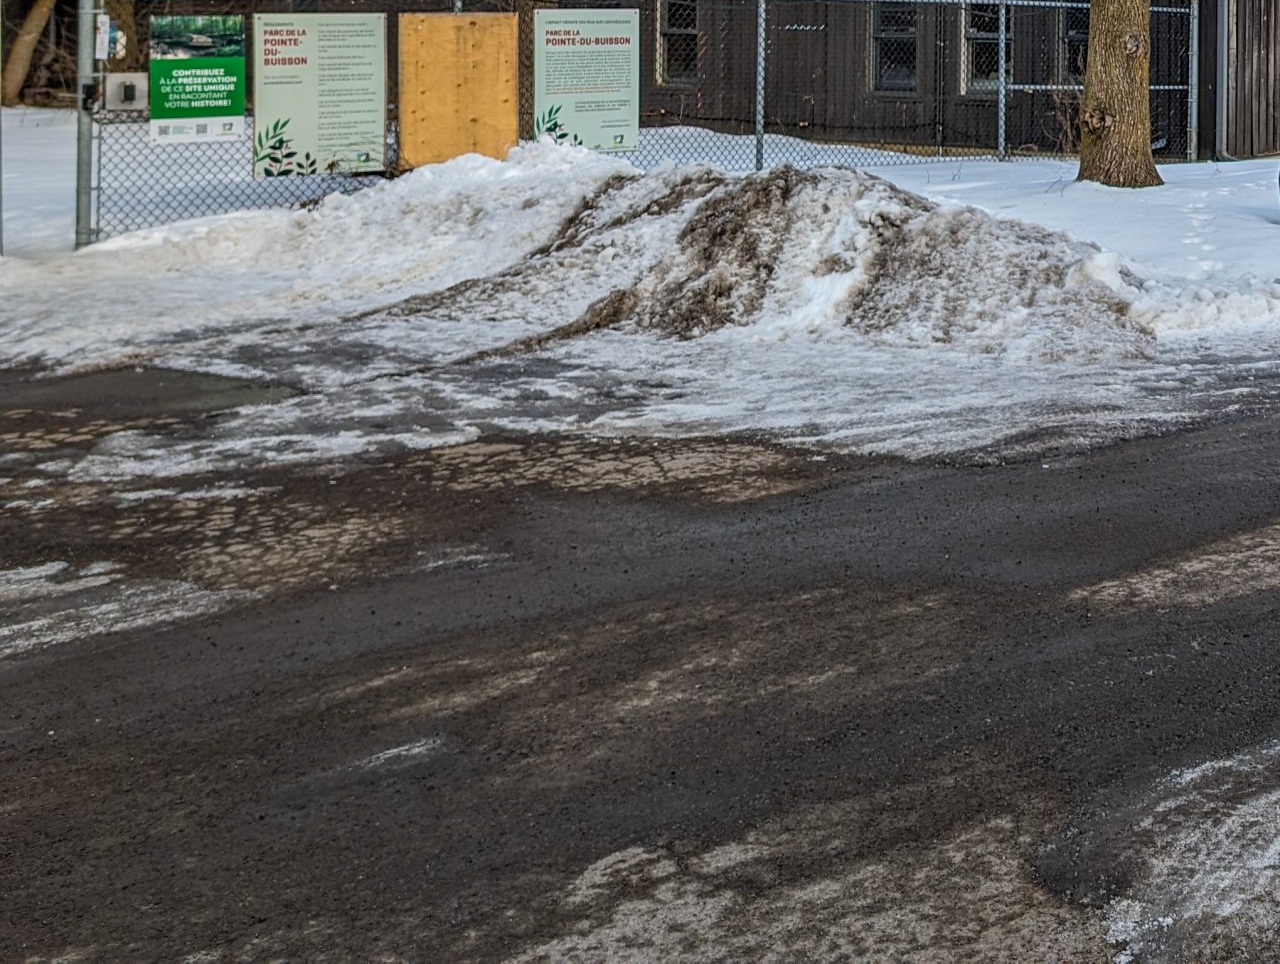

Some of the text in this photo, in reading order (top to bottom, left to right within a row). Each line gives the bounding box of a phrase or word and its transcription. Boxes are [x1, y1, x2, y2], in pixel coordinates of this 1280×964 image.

[264, 38, 303, 46] POINTE-
[546, 37, 630, 46] POINTE-DU-BUISSON
[264, 57, 307, 66] BUISSON
[178, 76, 236, 84] PRÉSERVATION
